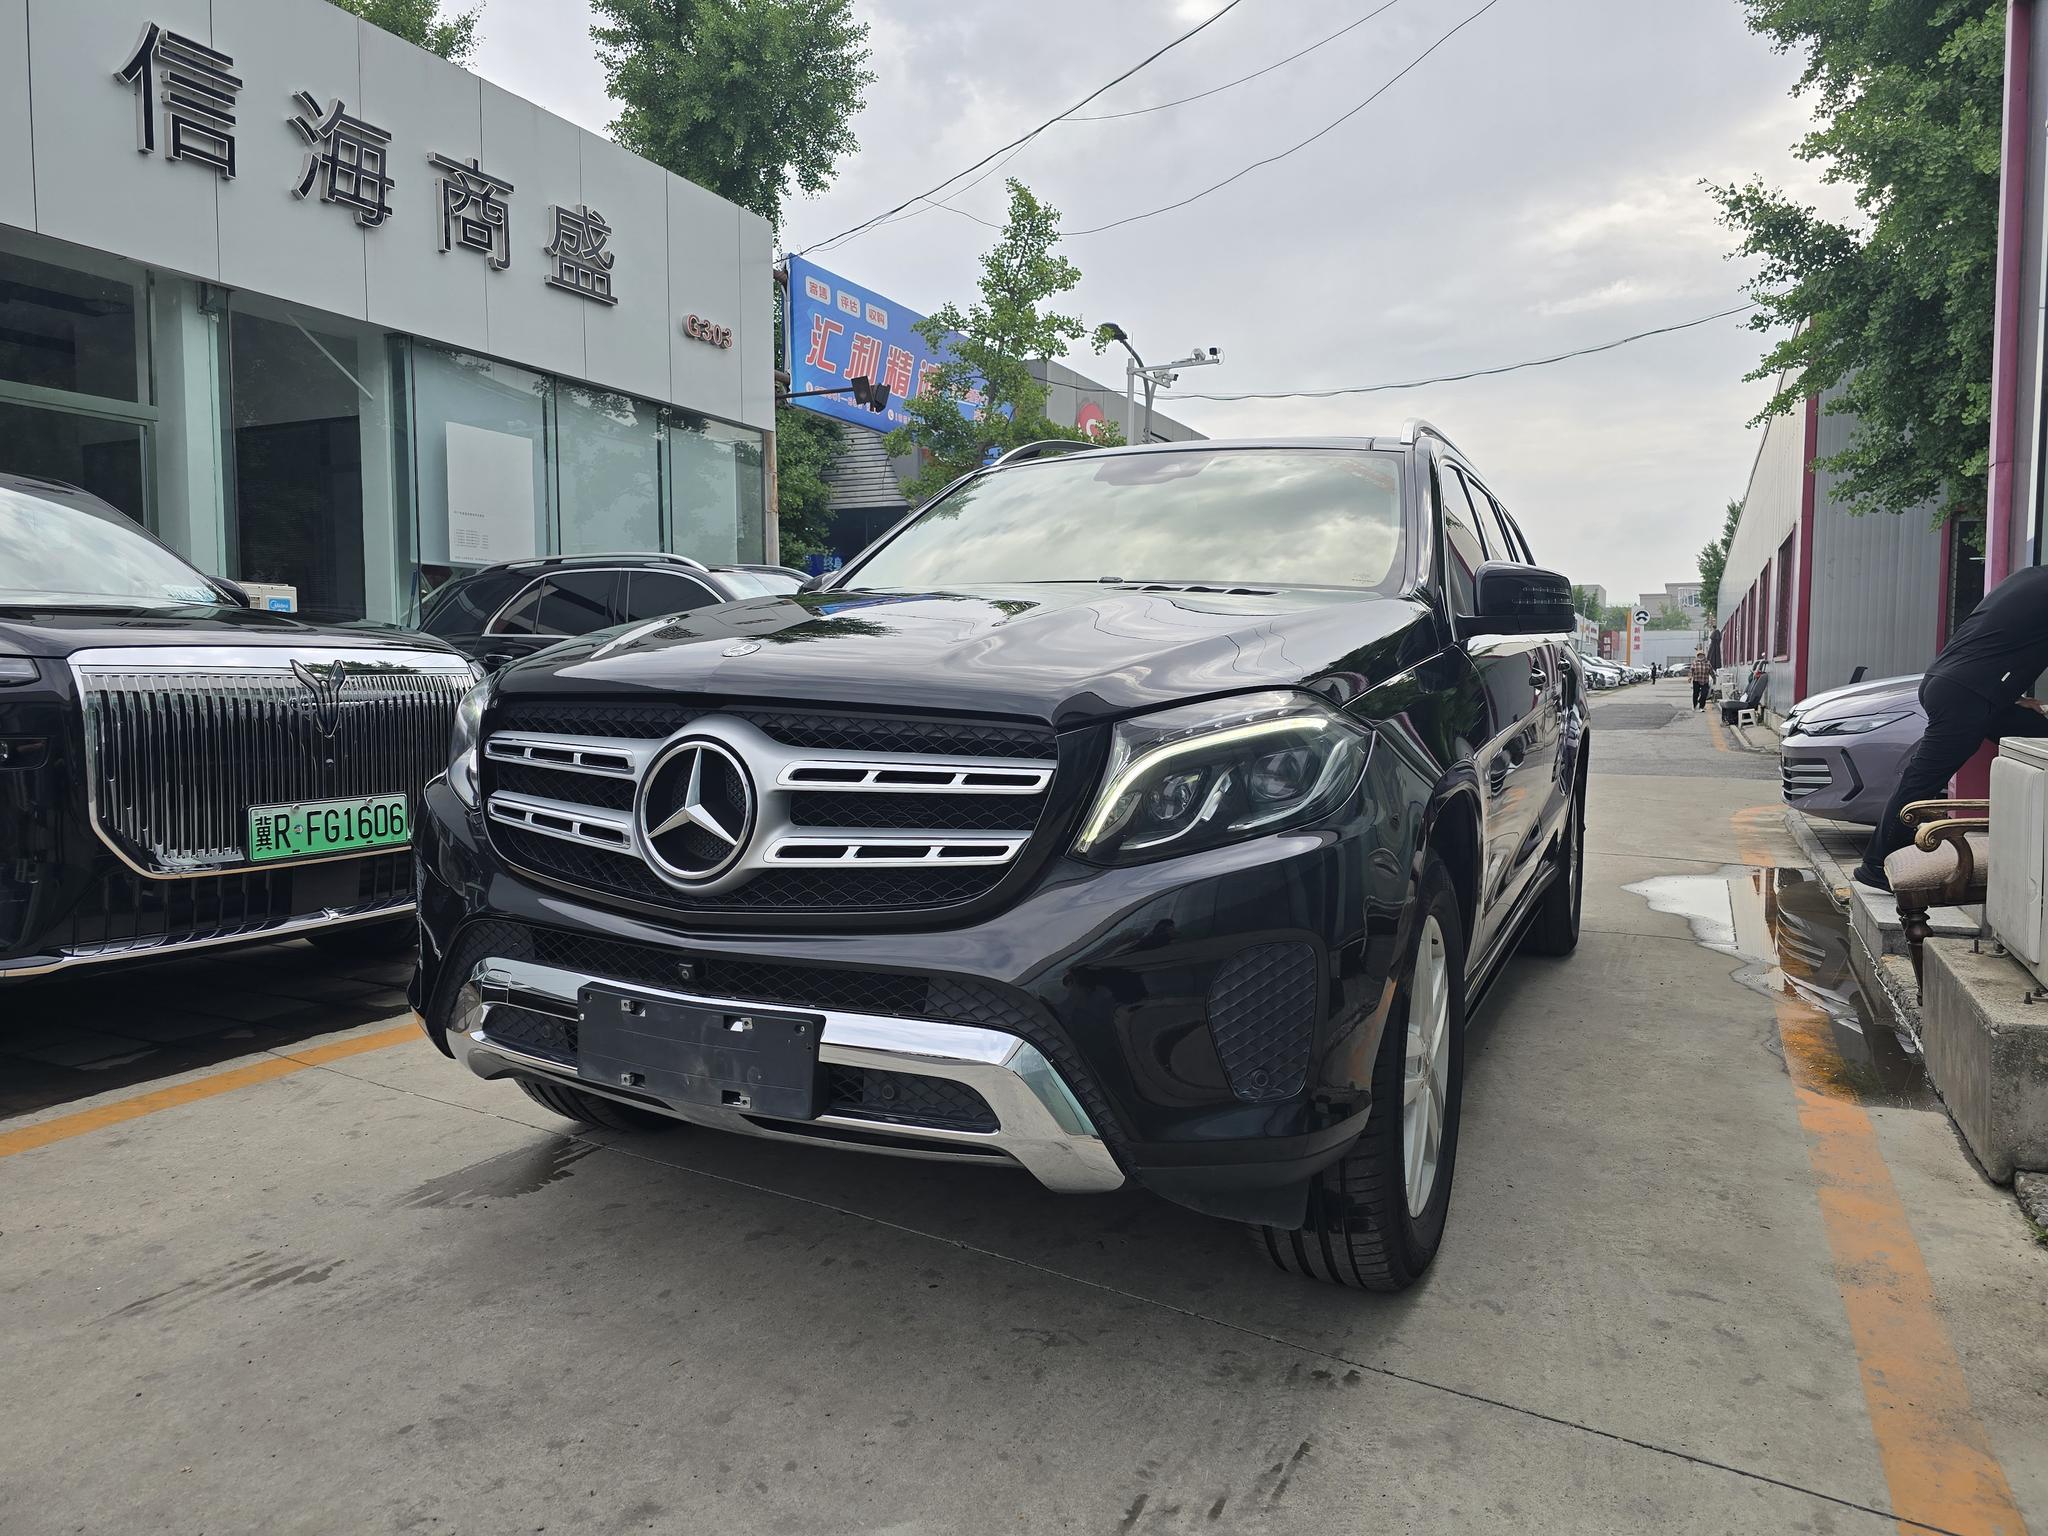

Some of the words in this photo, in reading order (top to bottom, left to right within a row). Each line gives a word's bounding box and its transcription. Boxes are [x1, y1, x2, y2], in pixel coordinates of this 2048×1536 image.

[113, 20, 619, 306] 信海商盛
[840, 295, 858, 313] 评估
[868, 308, 885, 326] 收购
[683, 314, 732, 349] G303
